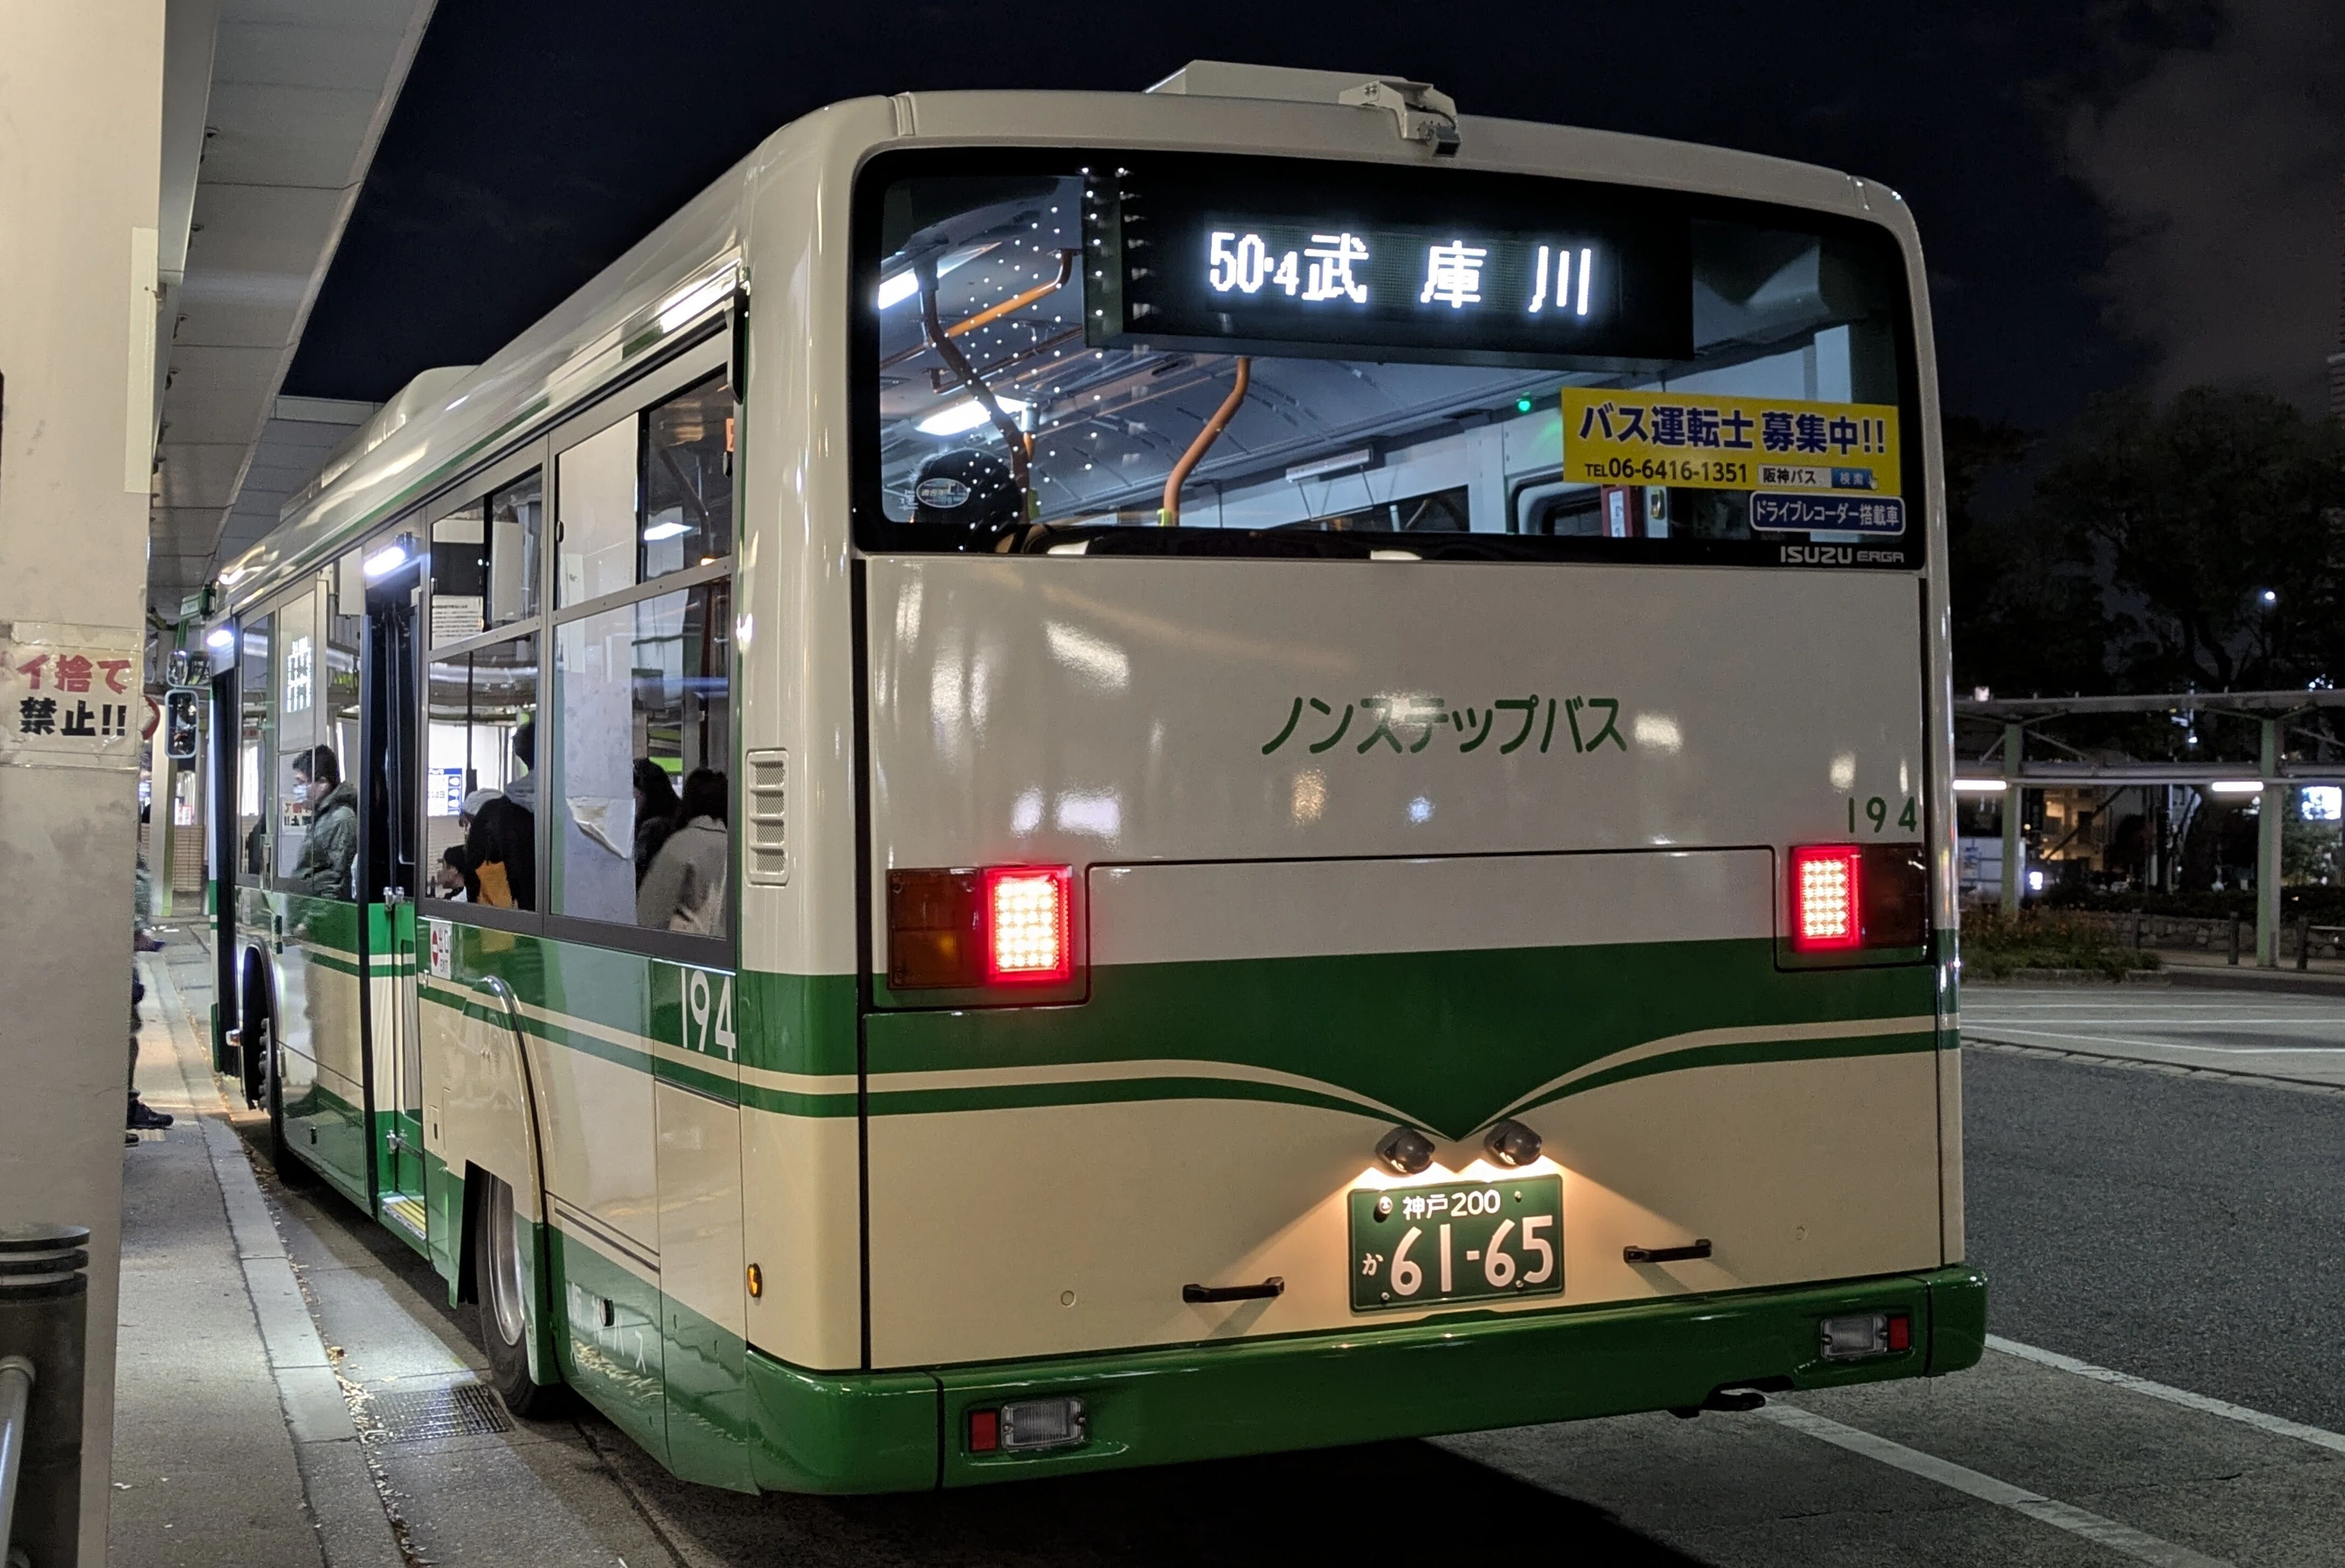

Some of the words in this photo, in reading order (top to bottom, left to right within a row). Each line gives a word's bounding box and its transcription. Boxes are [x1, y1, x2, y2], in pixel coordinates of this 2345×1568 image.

[1579, 402, 1754, 450] バス運転士
[1762, 412, 1885, 454] 募集中!!
[1584, 463, 1608, 477] TEL
[1609, 458, 1747, 483] 06-6416-1351
[1763, 468, 1817, 484] 阪神バス
[1756, 500, 1899, 526] ドライブレコーダー搭載車
[1780, 546, 1853, 563] ISUZU
[1856, 550, 1905, 563] ERGA
[0, 650, 131, 694] イ捨て
[20, 696, 127, 736] 禁止!!
[1262, 693, 1627, 755] ノンステップバス
[1848, 796, 1918, 833] 194
[680, 967, 736, 1061] 194
[1402, 1189, 1501, 1221] 神戸200
[1362, 1252, 1383, 1276] か
[1390, 1214, 1554, 1296] 61-65
